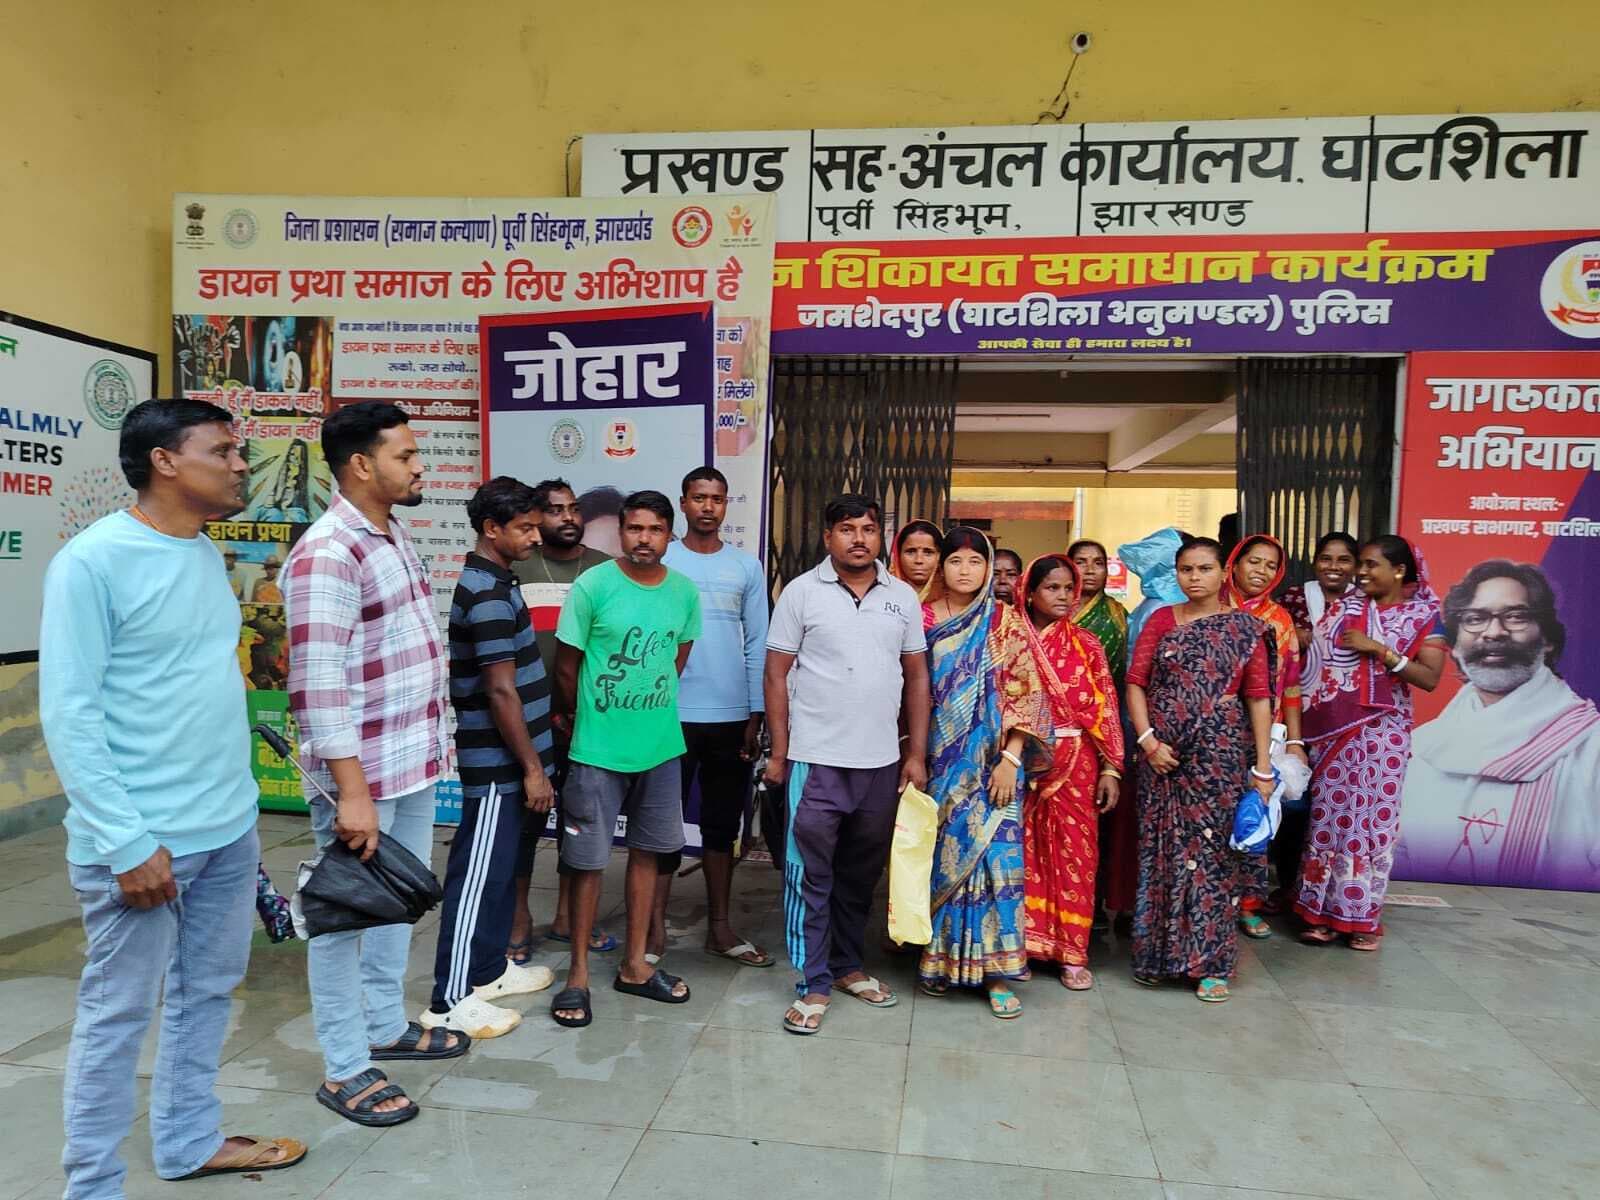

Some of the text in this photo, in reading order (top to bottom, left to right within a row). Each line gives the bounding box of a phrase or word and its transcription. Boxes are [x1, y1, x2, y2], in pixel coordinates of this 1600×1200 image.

[620, 147, 789, 195] प्रखण्ड
[1321, 116, 1589, 183] घाटशिला
[284, 211, 320, 241] जिला
[324, 219, 380, 243] प्रशासन
[385, 214, 437, 248] (समाज
[441, 214, 497, 249] कल्याण)
[502, 213, 527, 251] पूर्वी
[531, 211, 590, 250] सिंहभूम,
[595, 209, 653, 244] झारखंड
[815, 198, 1254, 236] पूर्वी सिंहभूम, झारखण्ड
[198, 255, 743, 304] डायन प्रथा समाज के लिए अभिशाप है
[815, 248, 1023, 289] शिकायत
[1030, 250, 1260, 287] समाधान
[1268, 240, 1495, 283] कार्यक्रम
[797, 289, 1393, 338] जमशेदपुर (घाटशिला अनुमण्डल) पुलिस
[977, 338, 1028, 349] आपकी
[1032, 338, 1062, 349] सेवा
[503, 331, 687, 402] जोहार
[0, 439, 64, 467] TERS
[0, 472, 53, 497] MER
[207, 522, 292, 542] डायन प्रथा
